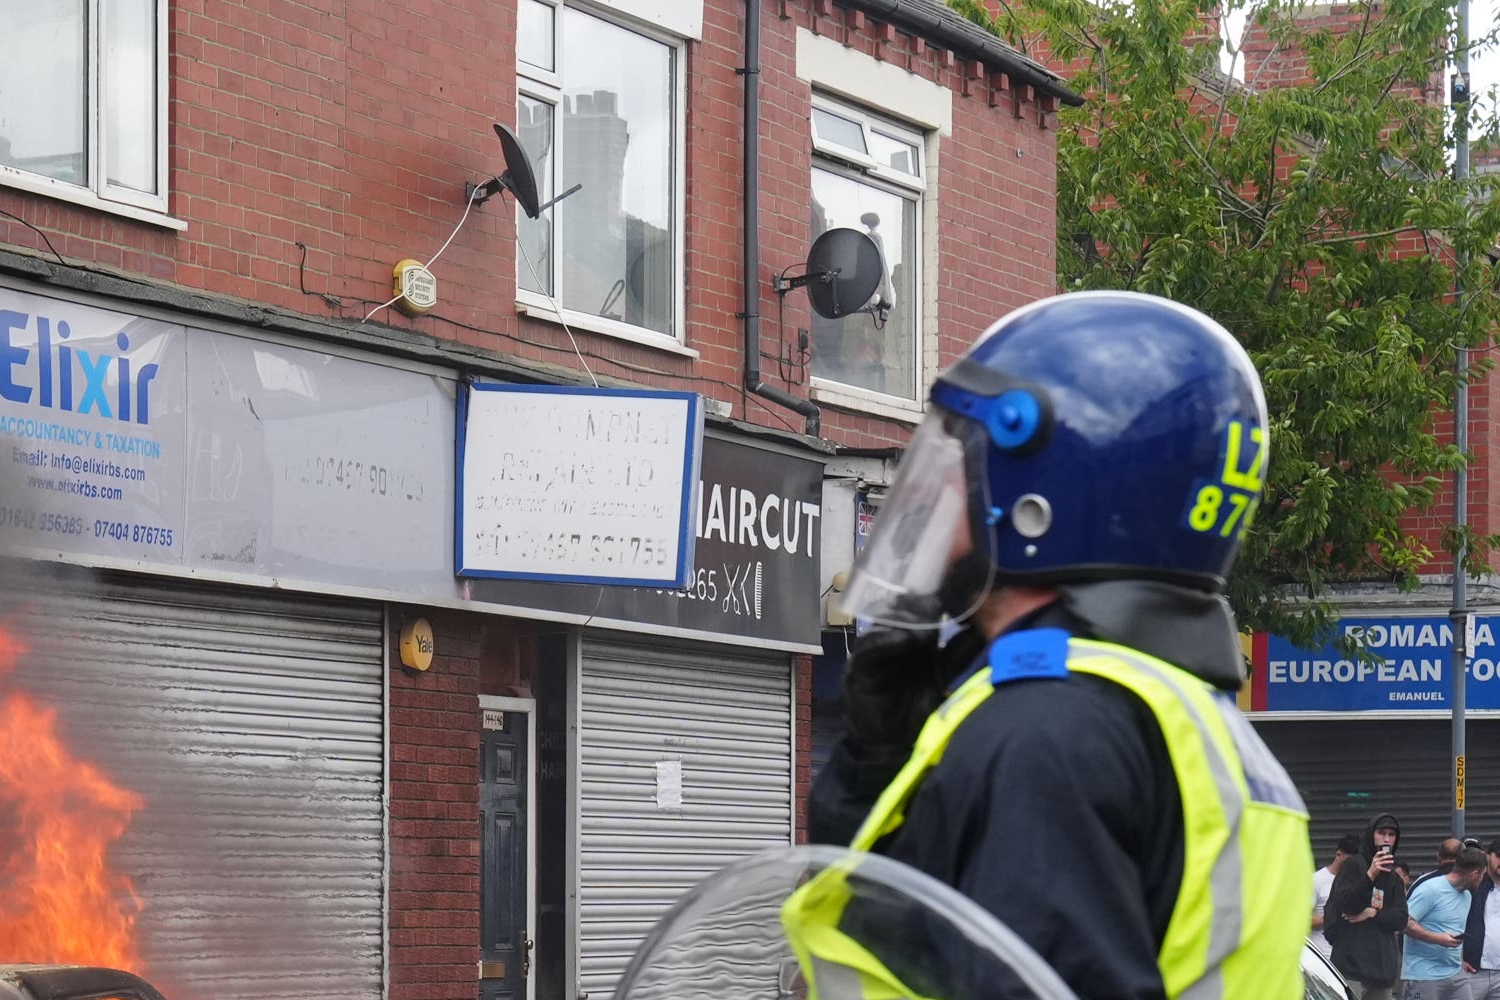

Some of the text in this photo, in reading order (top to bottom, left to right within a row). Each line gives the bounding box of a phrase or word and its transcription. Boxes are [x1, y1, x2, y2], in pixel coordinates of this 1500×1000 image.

[0, 415, 160, 459] ACCOUNTANCY & TAXATION
[28, 475, 123, 500] www.elixirbs.com
[94, 519, 129, 541] 07404
[133, 524, 173, 547] 876755
[416, 635, 432, 653] Yale
[1345, 624, 1495, 647] ROMANA
[1269, 658, 1442, 682] EUROPEAN
[1389, 691, 1445, 701] EMANUEL
